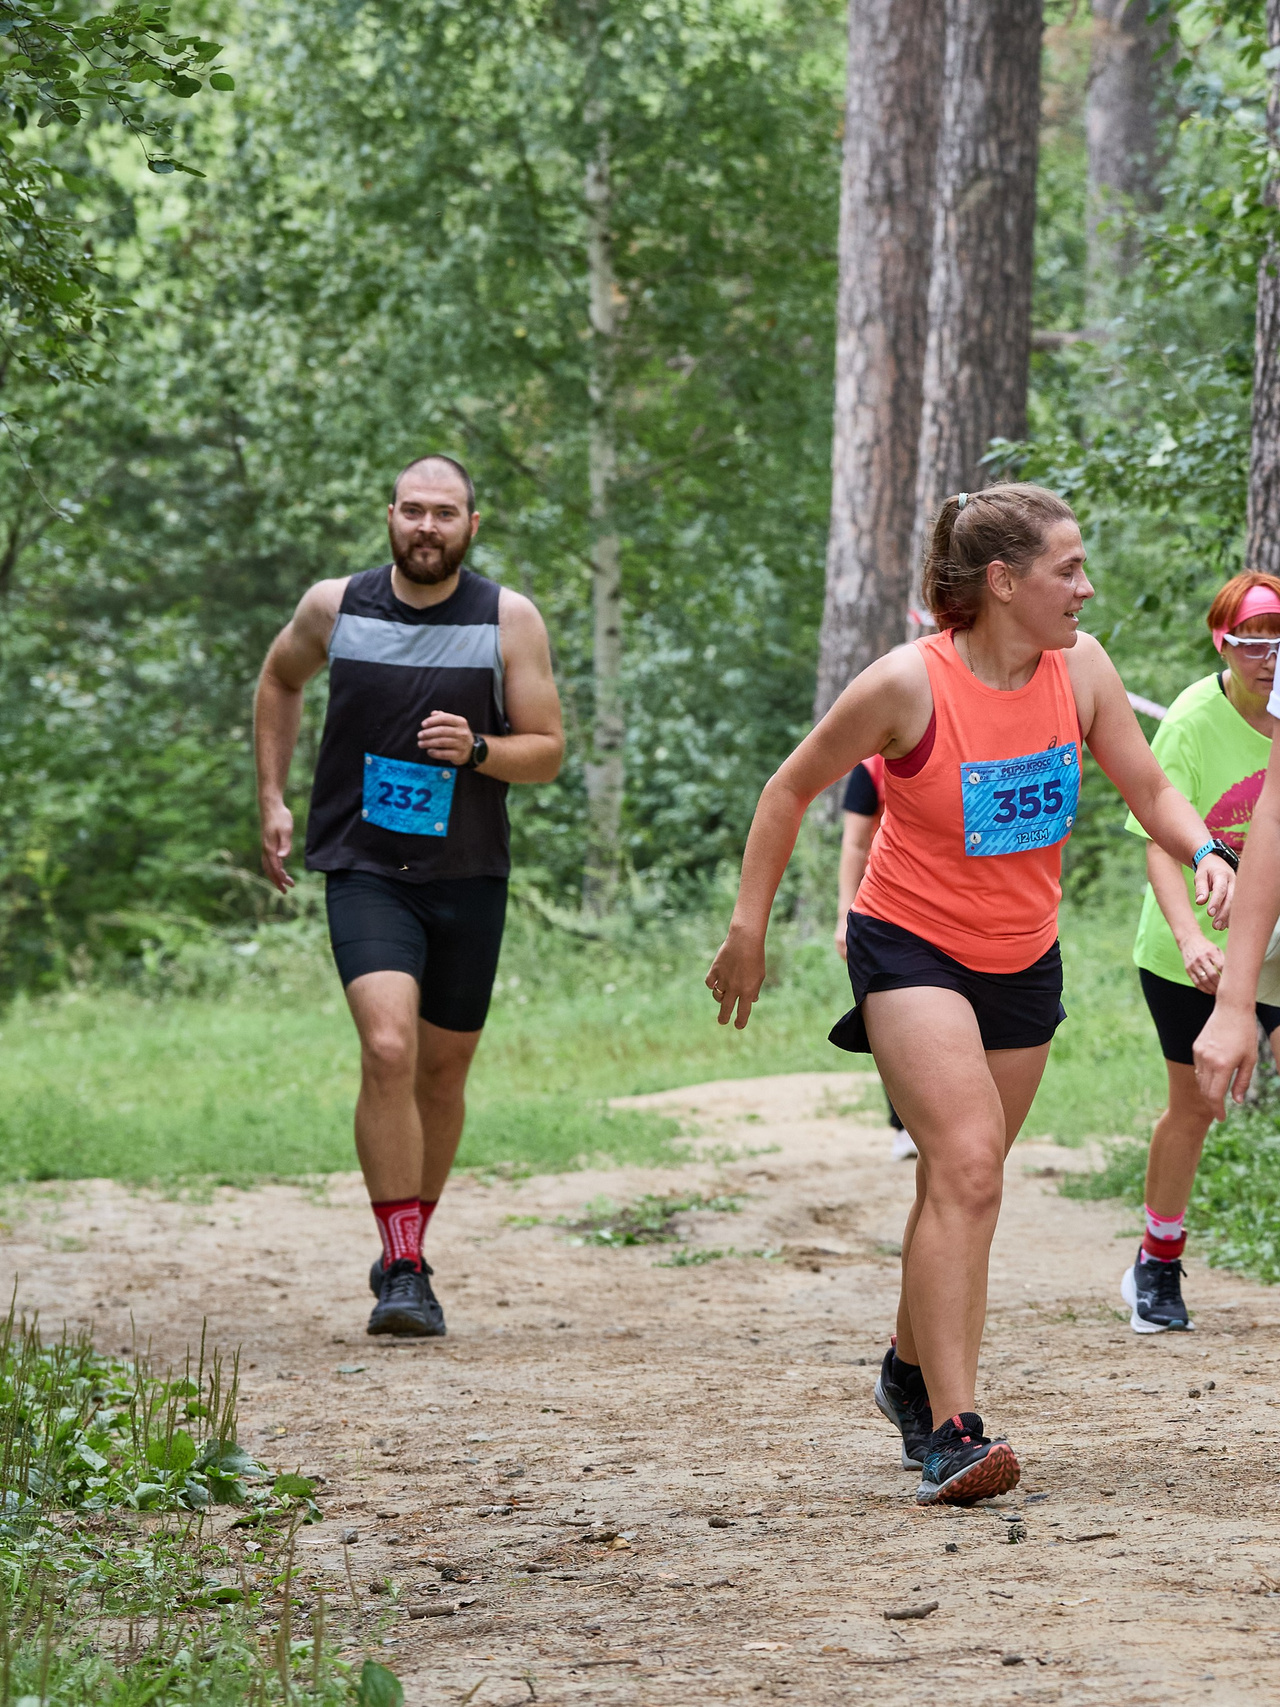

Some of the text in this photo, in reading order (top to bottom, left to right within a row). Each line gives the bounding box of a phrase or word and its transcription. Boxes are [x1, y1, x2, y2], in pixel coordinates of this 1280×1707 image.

[378, 781, 432, 813] 232
[993, 779, 1063, 824] 355
[1016, 832, 1029, 844] 12
